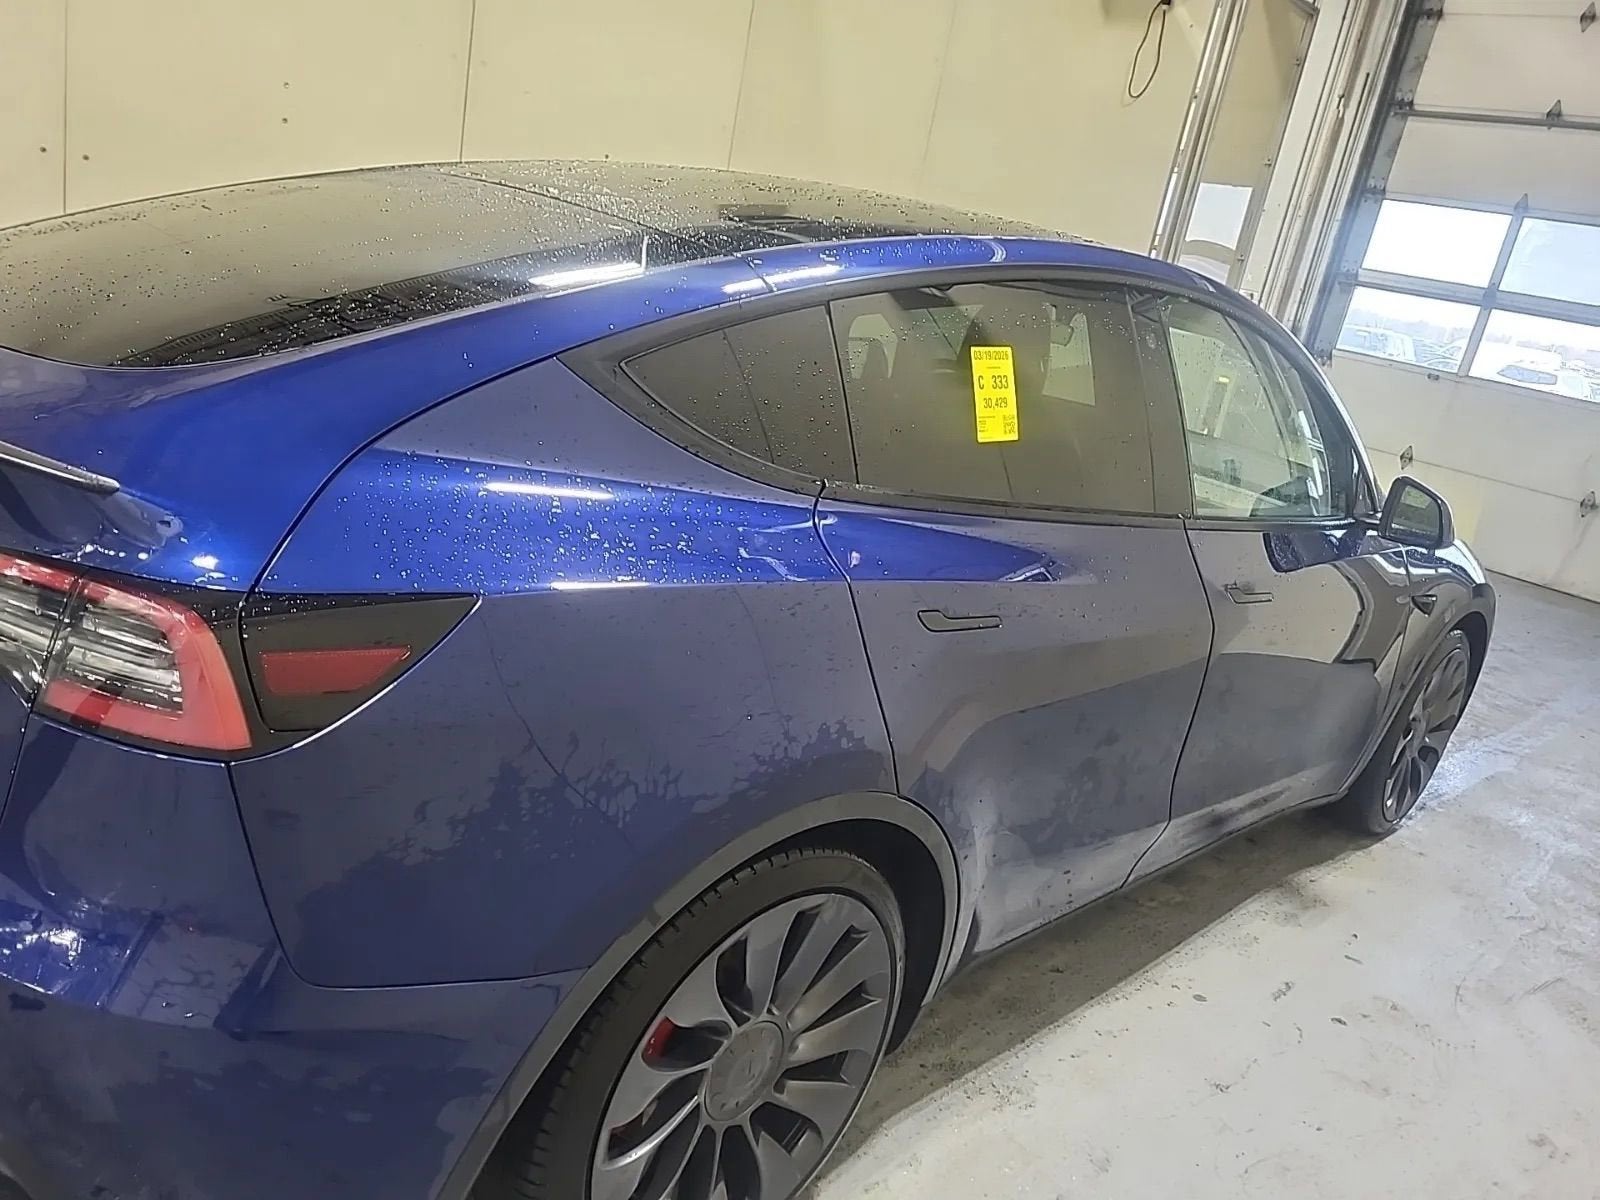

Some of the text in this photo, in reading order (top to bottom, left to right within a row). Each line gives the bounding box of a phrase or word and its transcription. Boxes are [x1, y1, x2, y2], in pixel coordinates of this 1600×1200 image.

[973, 350, 1009, 360] 03/19/2026
[978, 374, 1009, 390] C 333
[983, 396, 1008, 410] 30,429
